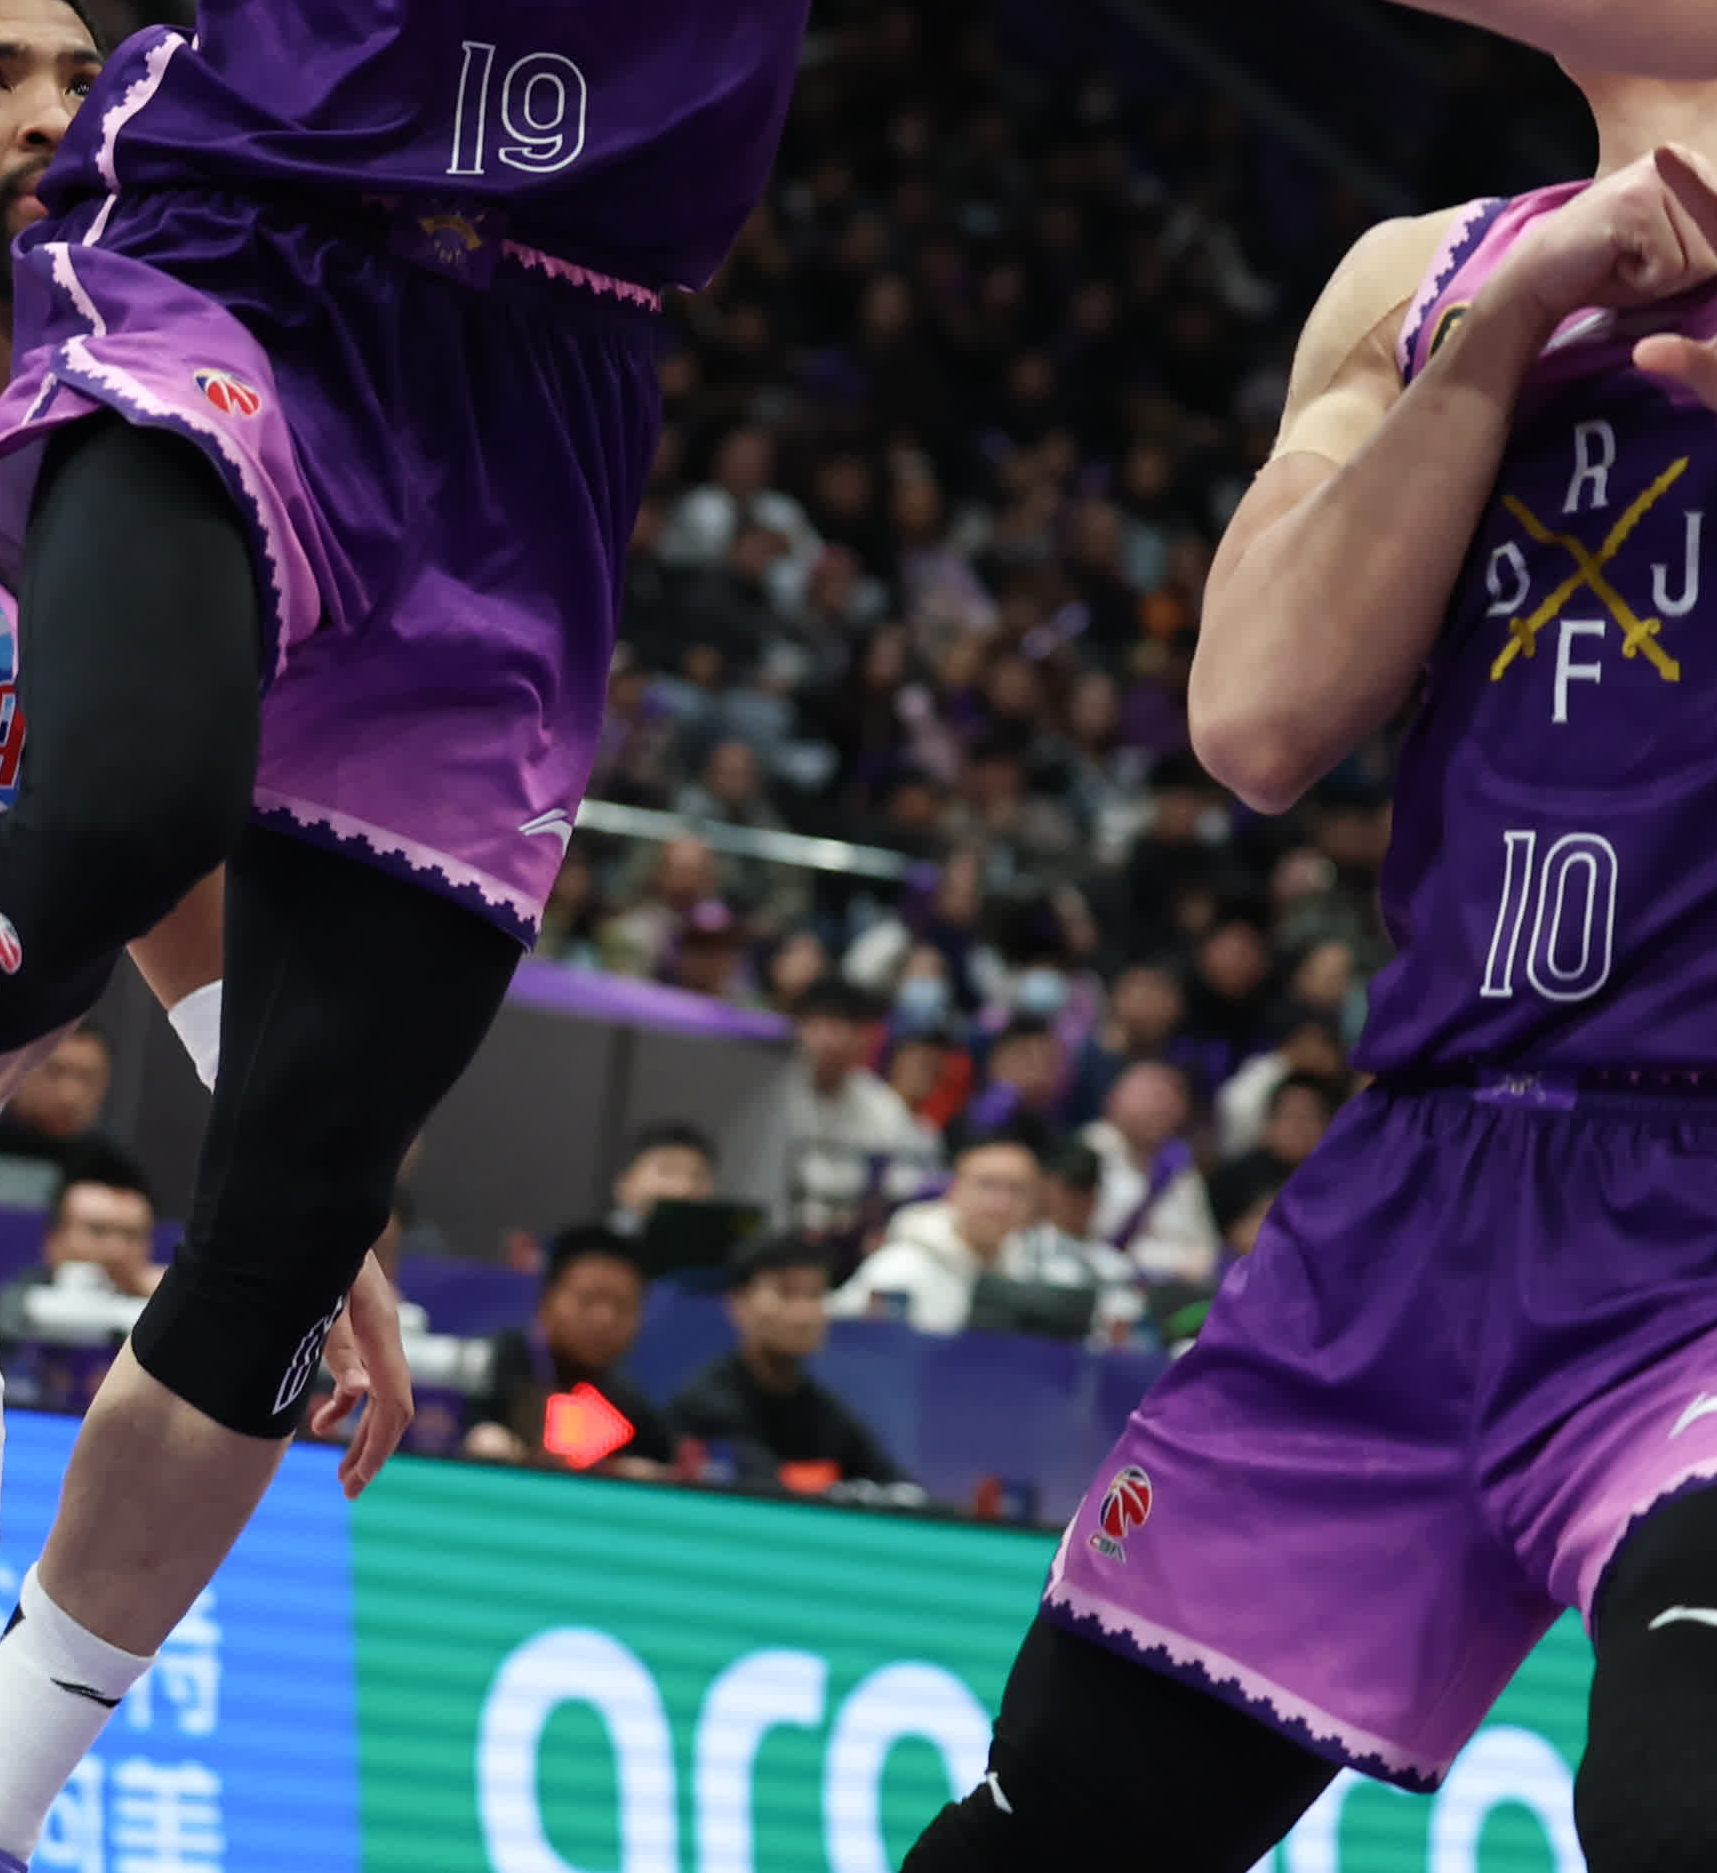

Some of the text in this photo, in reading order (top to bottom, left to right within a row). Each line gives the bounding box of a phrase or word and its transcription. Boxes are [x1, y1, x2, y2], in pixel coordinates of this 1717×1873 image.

[446, 40, 588, 173] 19
[1562, 417, 1617, 514] R
[1651, 511, 1705, 616] J
[1551, 619, 1606, 725] F
[1480, 830, 1619, 1003] 10
